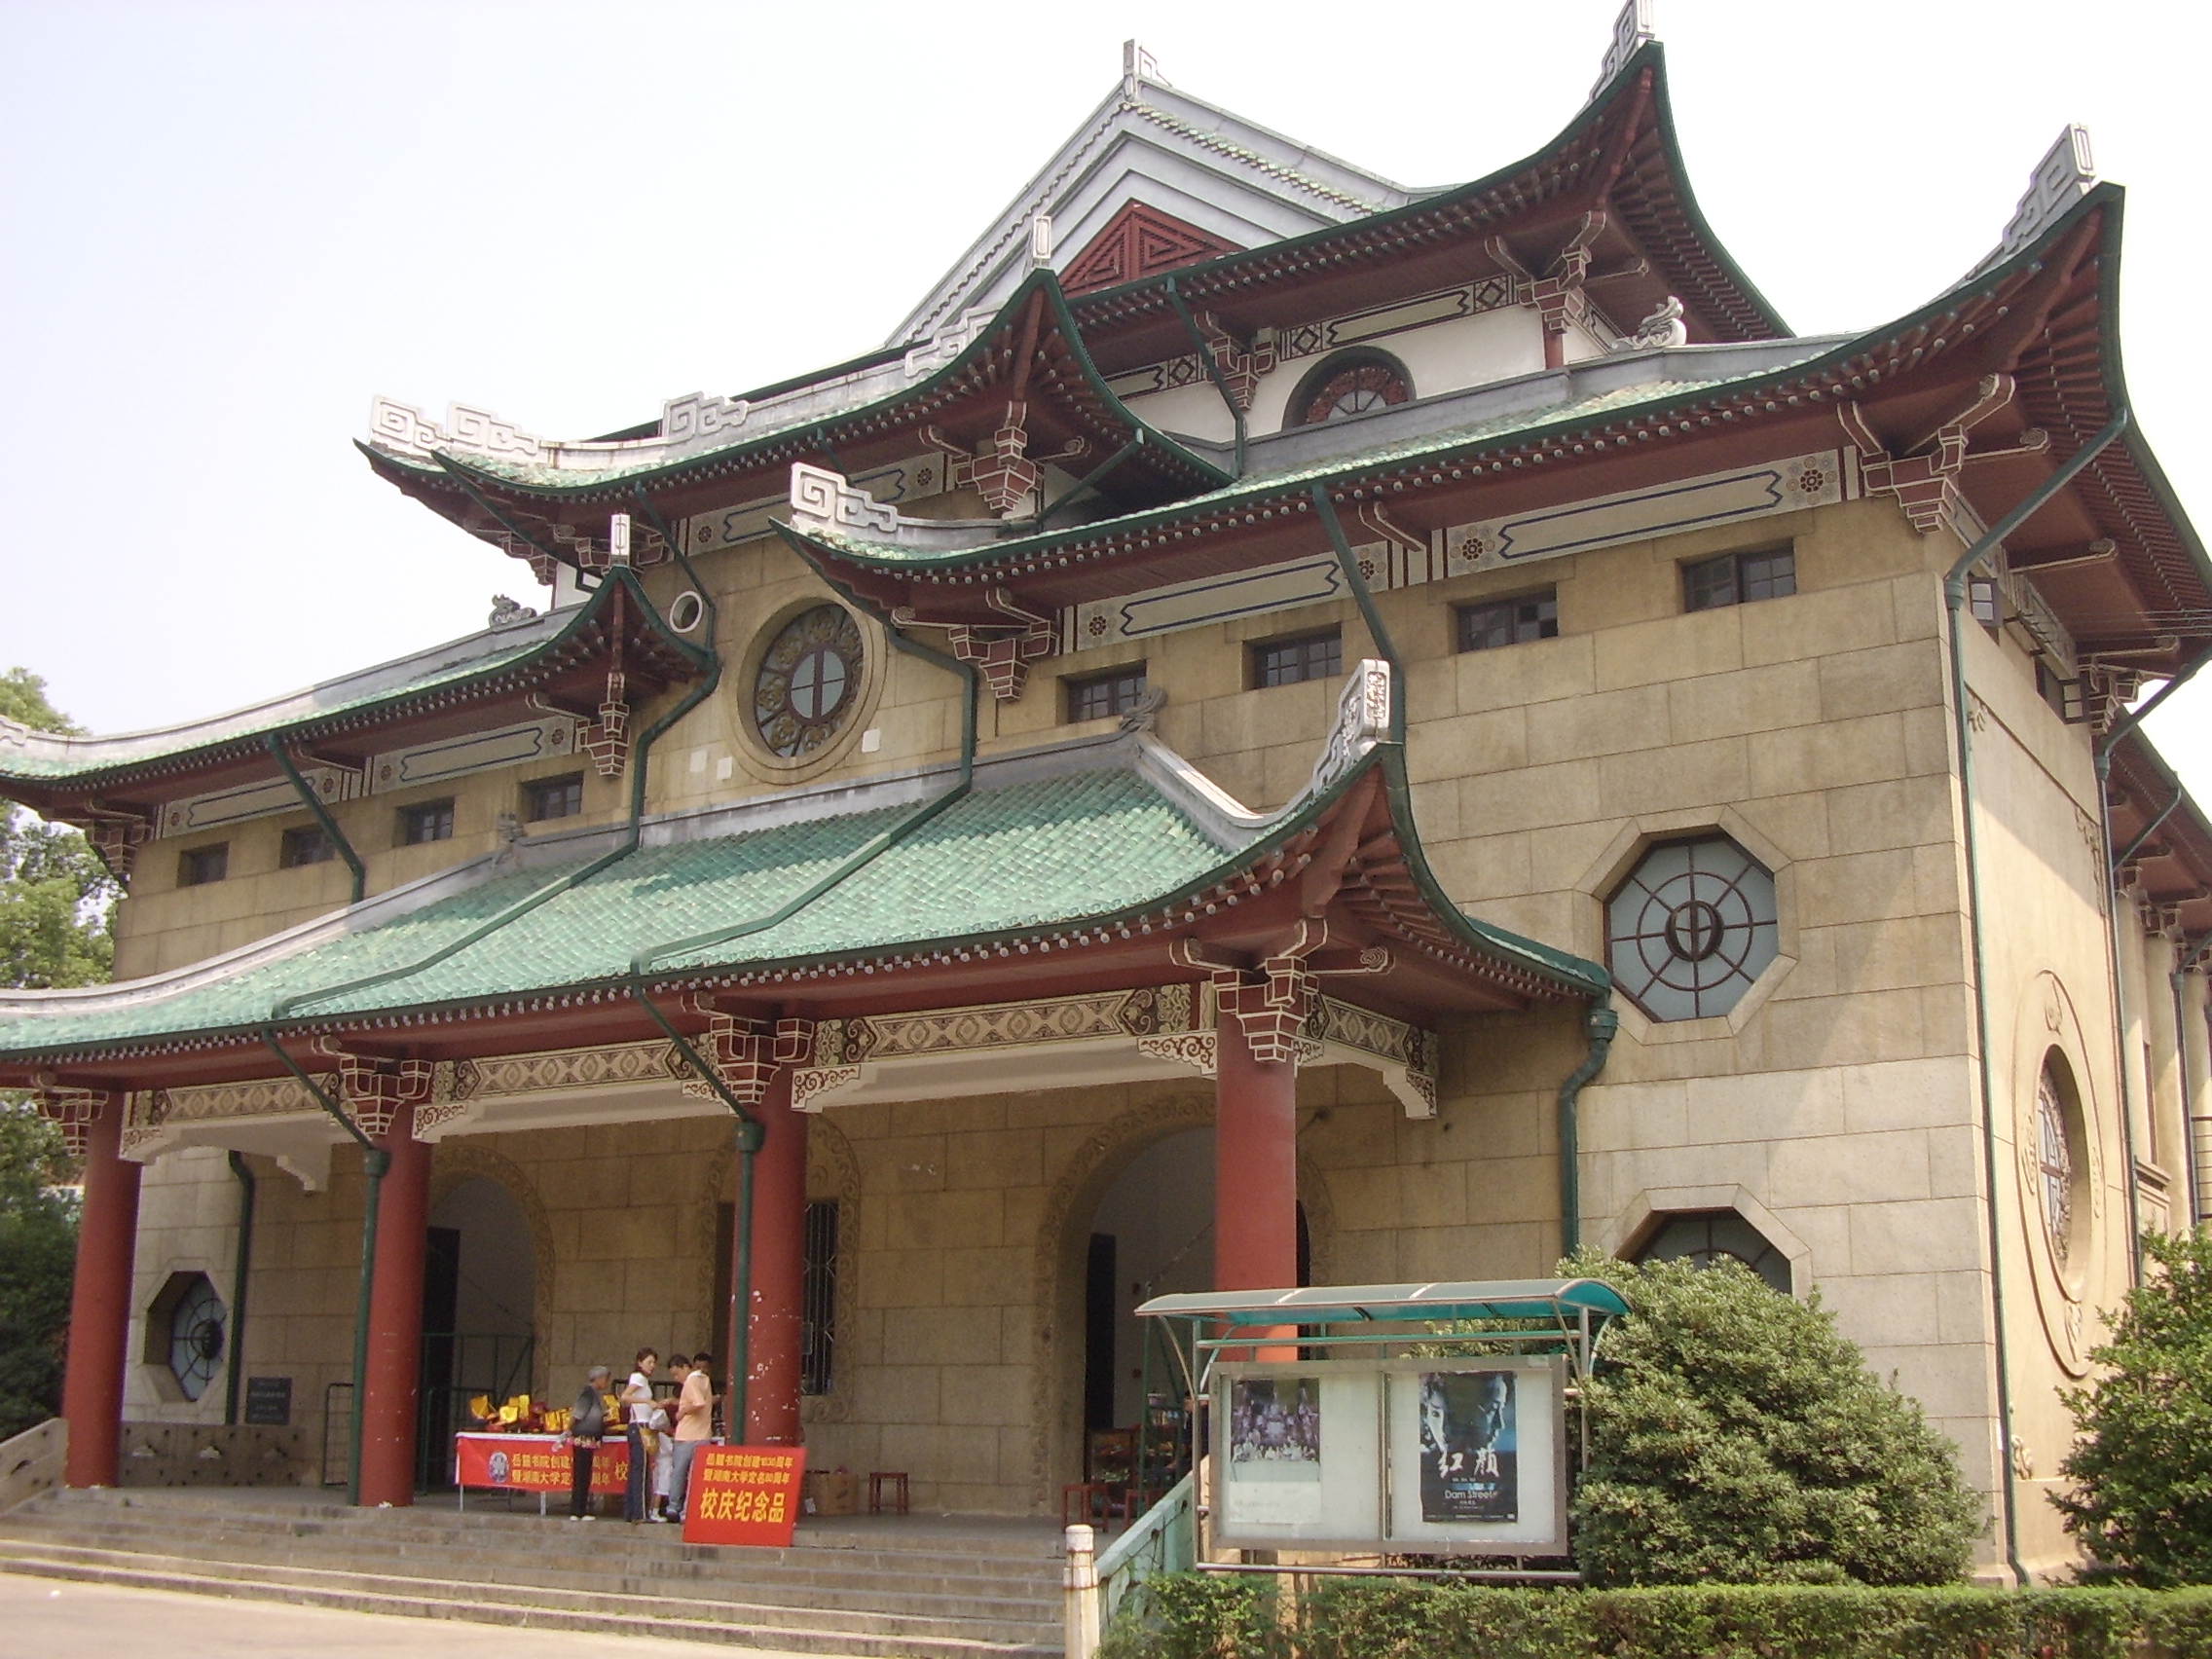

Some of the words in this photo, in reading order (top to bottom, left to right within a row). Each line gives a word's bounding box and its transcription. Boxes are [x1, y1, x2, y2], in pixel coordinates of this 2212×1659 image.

[700, 1487, 786, 1524] 校庆纪念品
[1445, 1490, 1465, 1499] Dam
